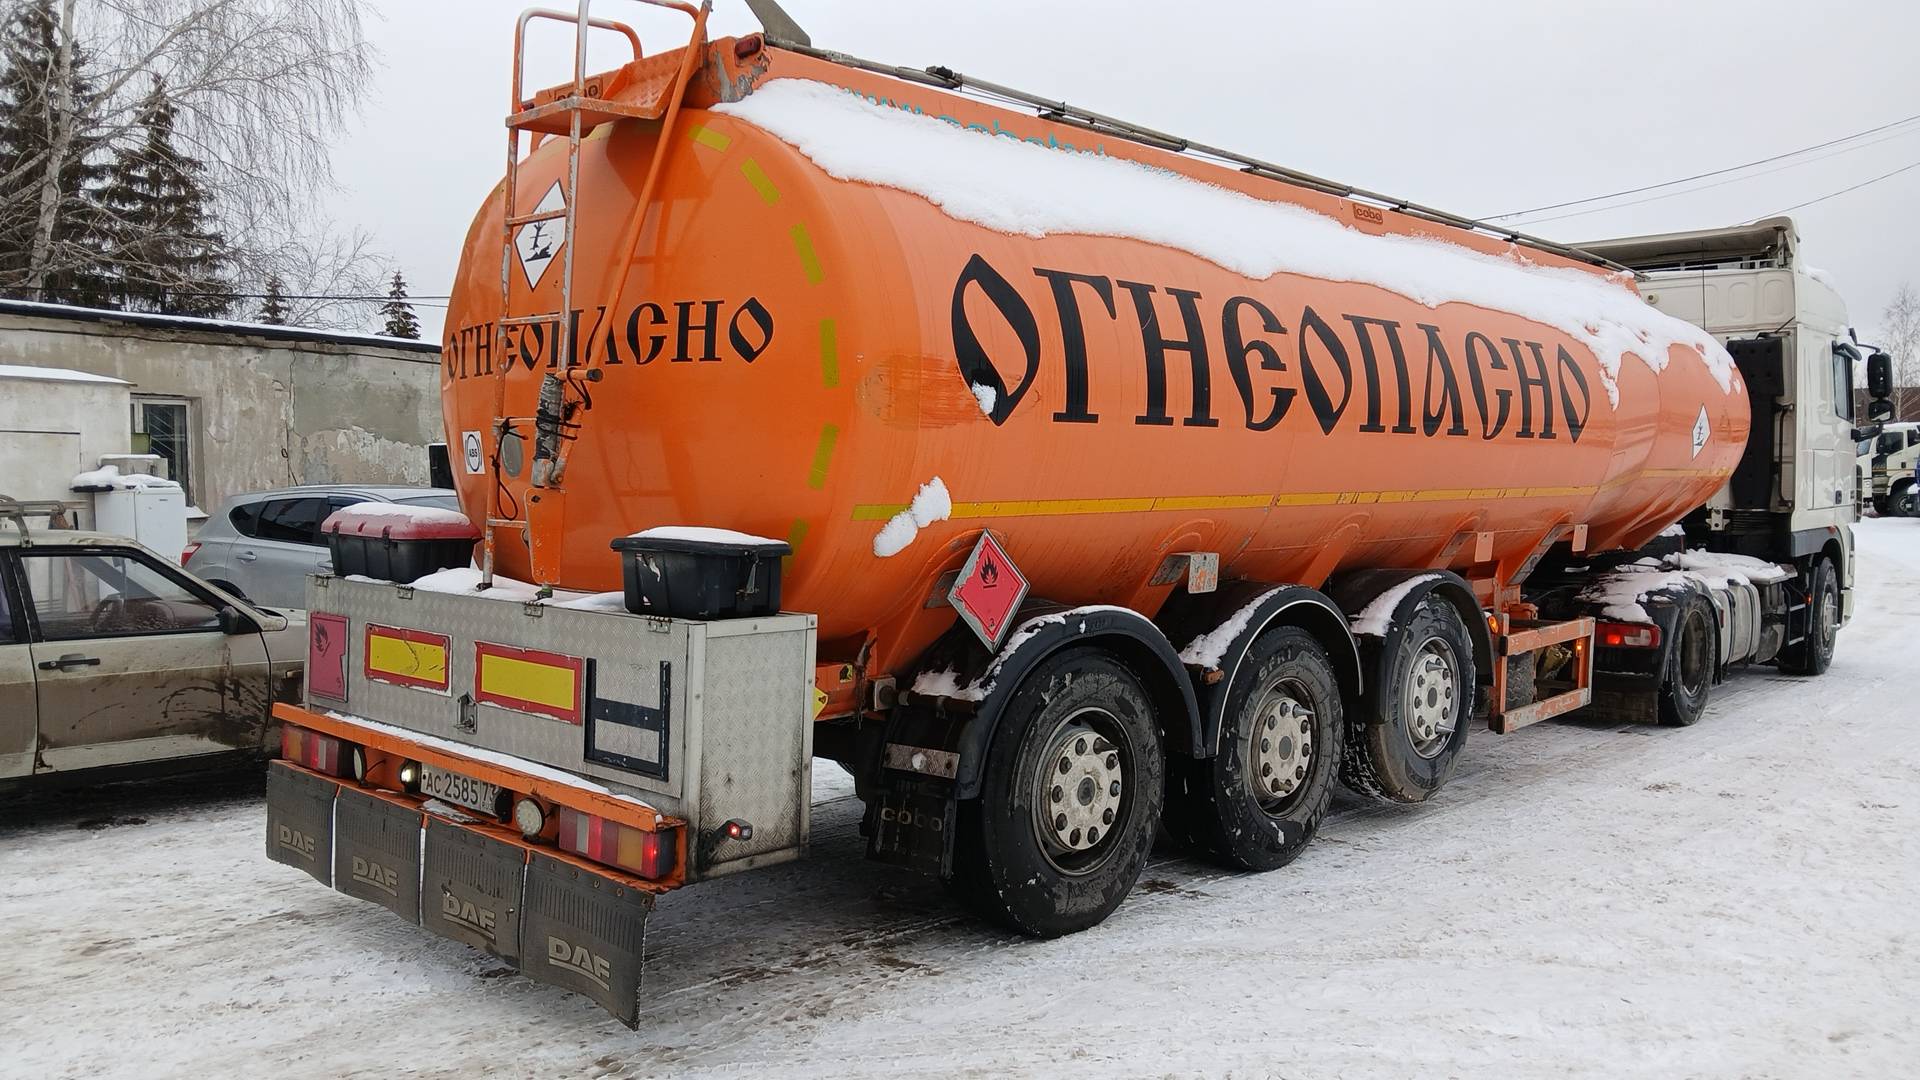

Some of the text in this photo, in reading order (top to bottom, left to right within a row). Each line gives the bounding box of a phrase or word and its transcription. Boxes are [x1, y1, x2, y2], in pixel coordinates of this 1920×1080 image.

[1356, 208, 1381, 221] cobo
[447, 297, 774, 383] ОГНЕОПАСНО
[951, 254, 1590, 443] ОГНЕОПАСНО
[444, 773, 478, 805] 2585
[279, 824, 315, 852] DAF
[352, 855, 399, 889] DAF
[443, 892, 497, 930] DAF
[548, 935, 610, 978] DAF
